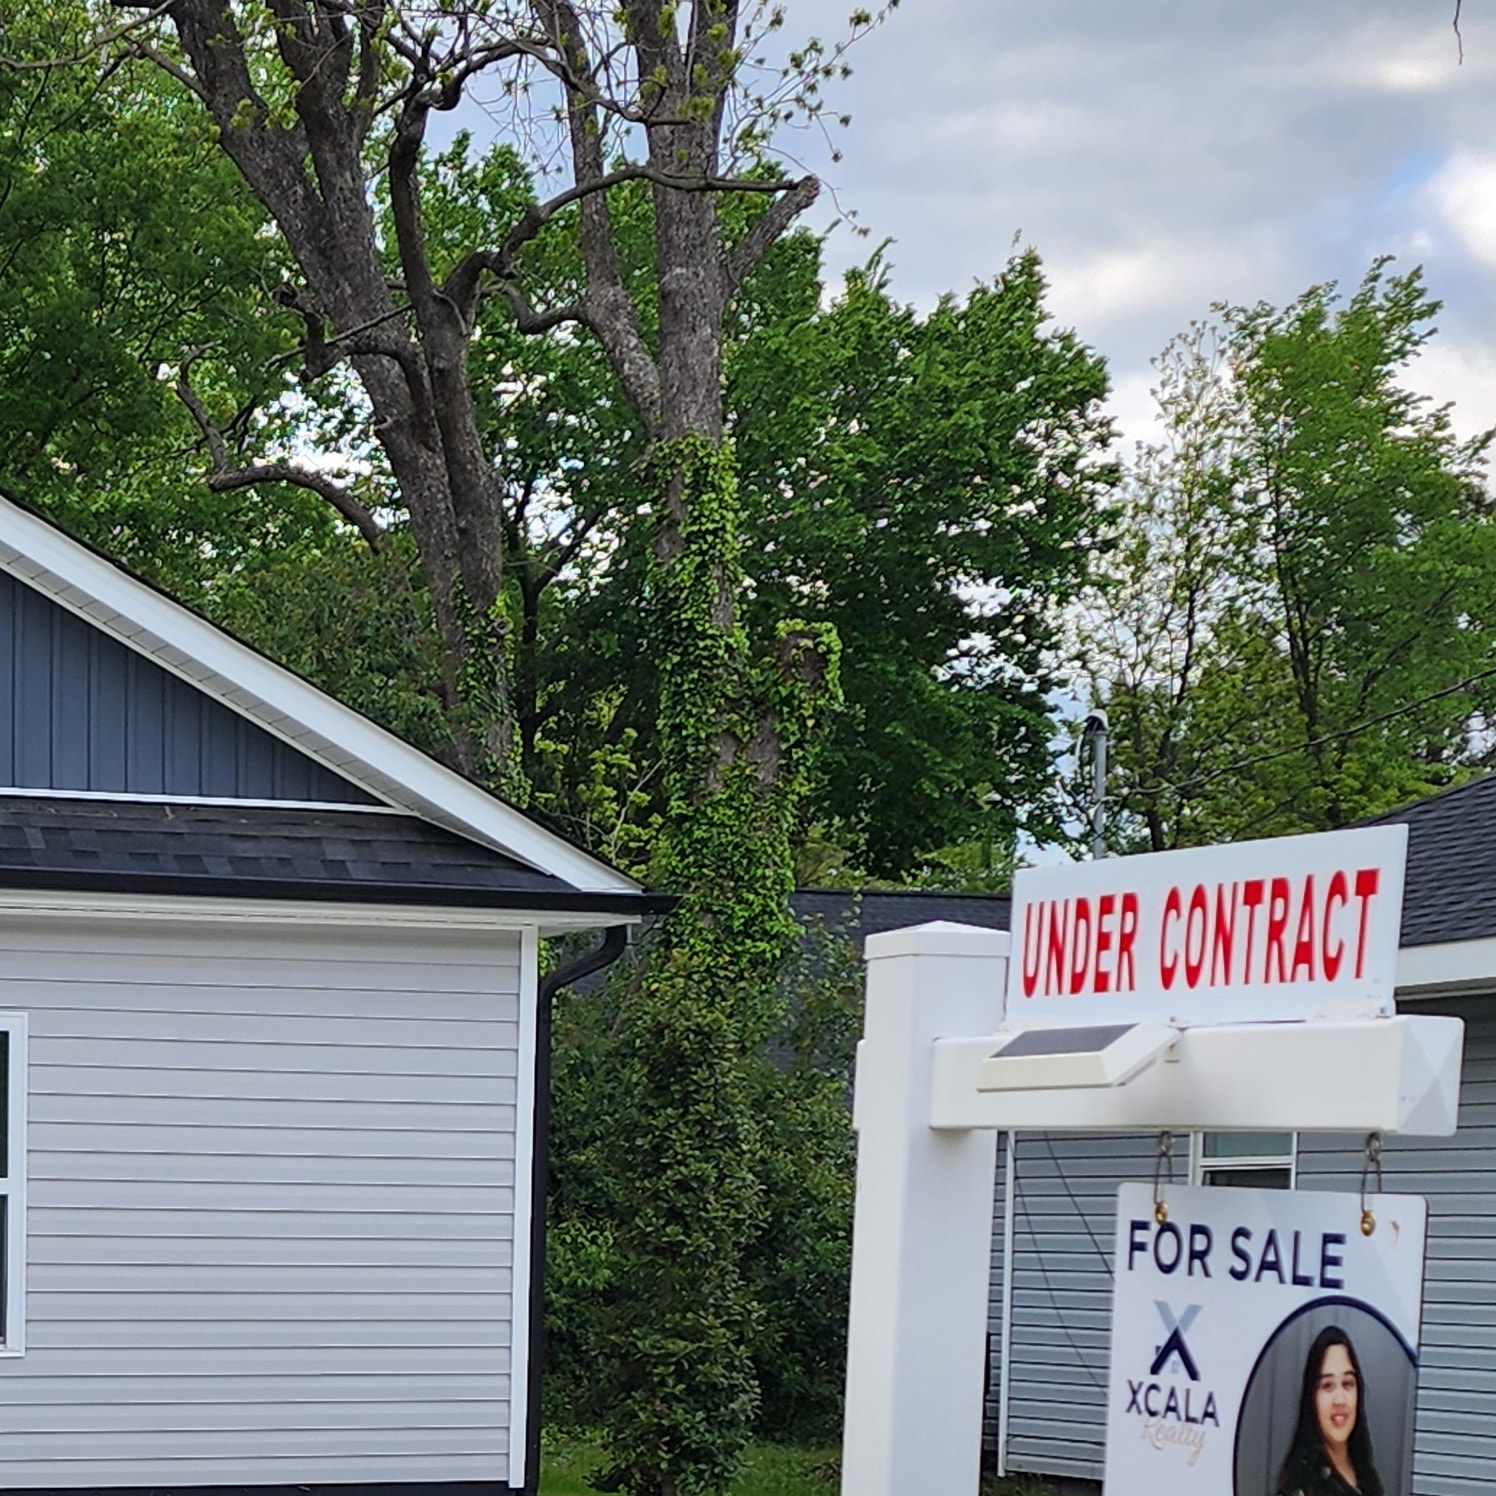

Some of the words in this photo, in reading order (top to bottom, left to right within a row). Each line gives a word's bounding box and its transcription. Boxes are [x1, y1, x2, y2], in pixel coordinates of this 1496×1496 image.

[1022, 891, 1140, 999] UNDER
[1159, 867, 1381, 992] CONTRACT
[1126, 1218, 1214, 1279] FOR
[1227, 1225, 1348, 1290] SALE
[1124, 1378, 1221, 1428] XCALA
[1140, 1417, 1207, 1467] Realty
